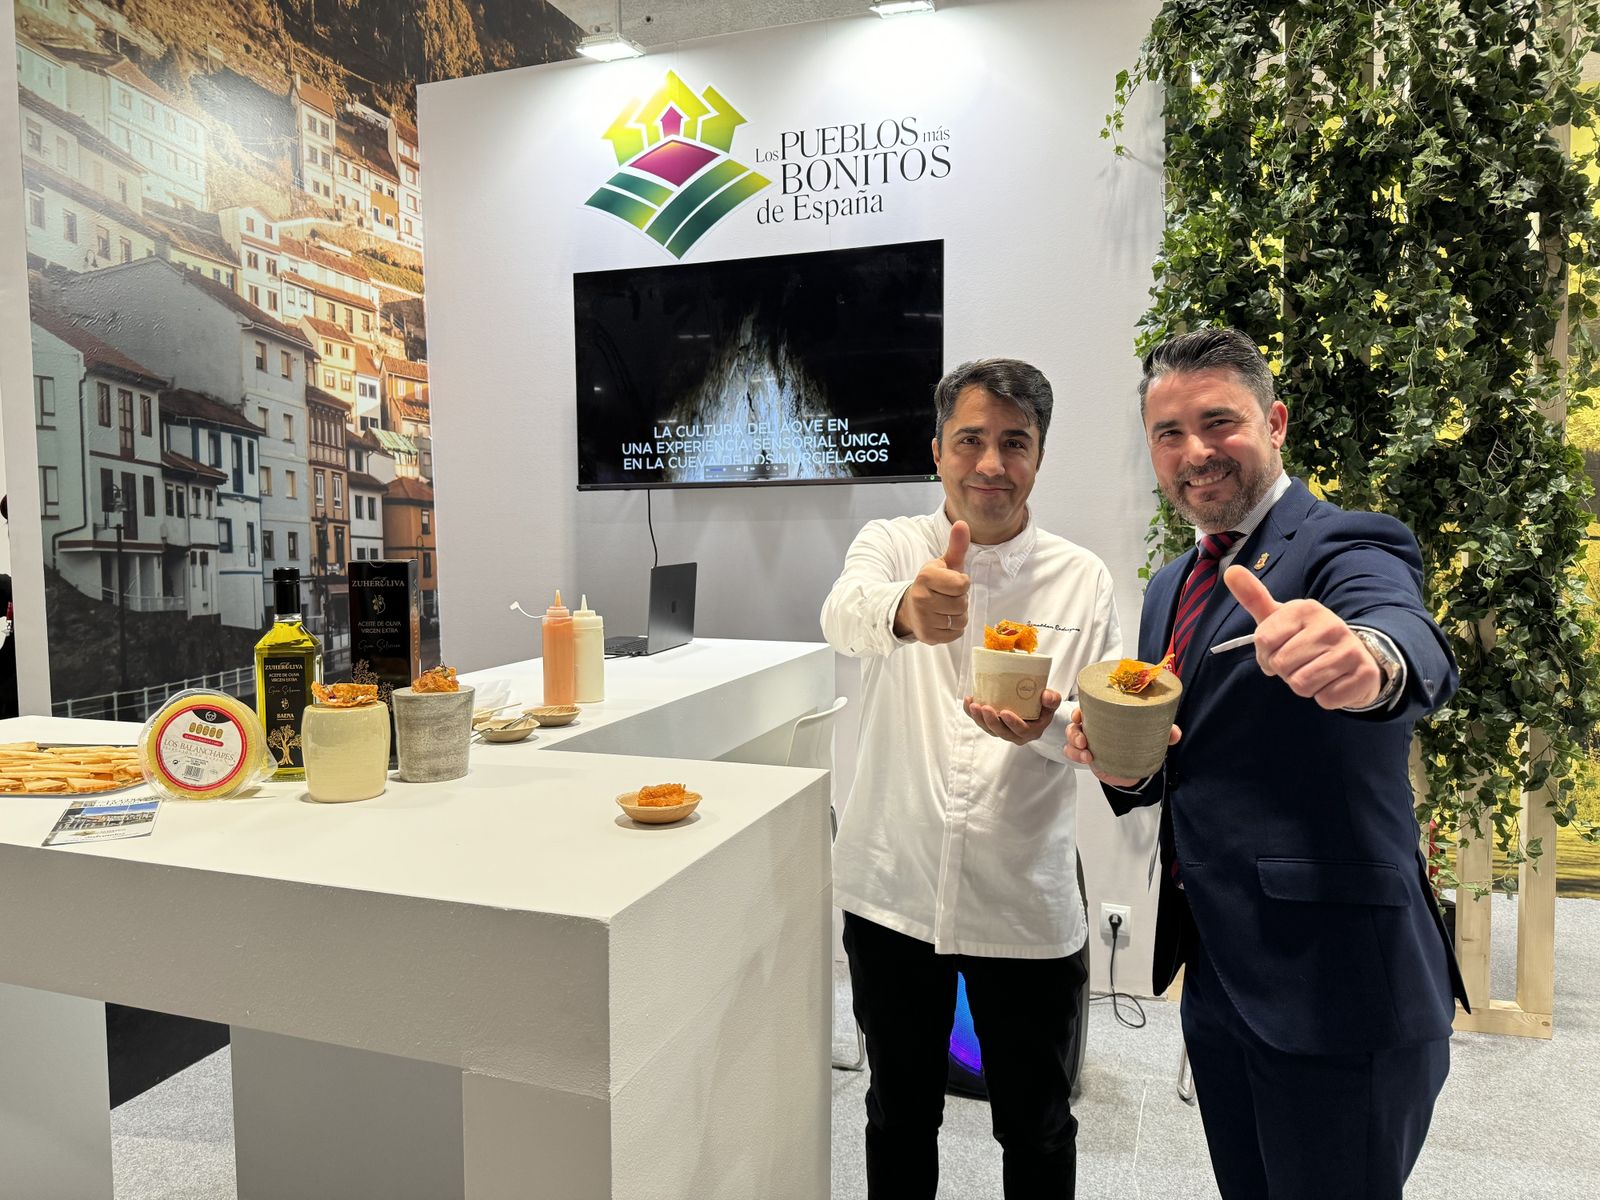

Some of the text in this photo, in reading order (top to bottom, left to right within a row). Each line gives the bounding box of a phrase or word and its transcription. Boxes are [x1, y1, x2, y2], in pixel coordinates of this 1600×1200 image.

[756, 116, 951, 163] Los PUEBLOS más
[781, 145, 952, 195] BONITOS
[757, 189, 884, 225] de España
[653, 418, 849, 439] LA CULTURA DEL AOVE EN
[622, 431, 891, 455] UNA EXPERIENCIA SENSORIAL ÚNICA
[623, 448, 889, 470] EN LA CUEVA DE LOS MURCIÉLAGOS
[164, 740, 178, 748] LOS
